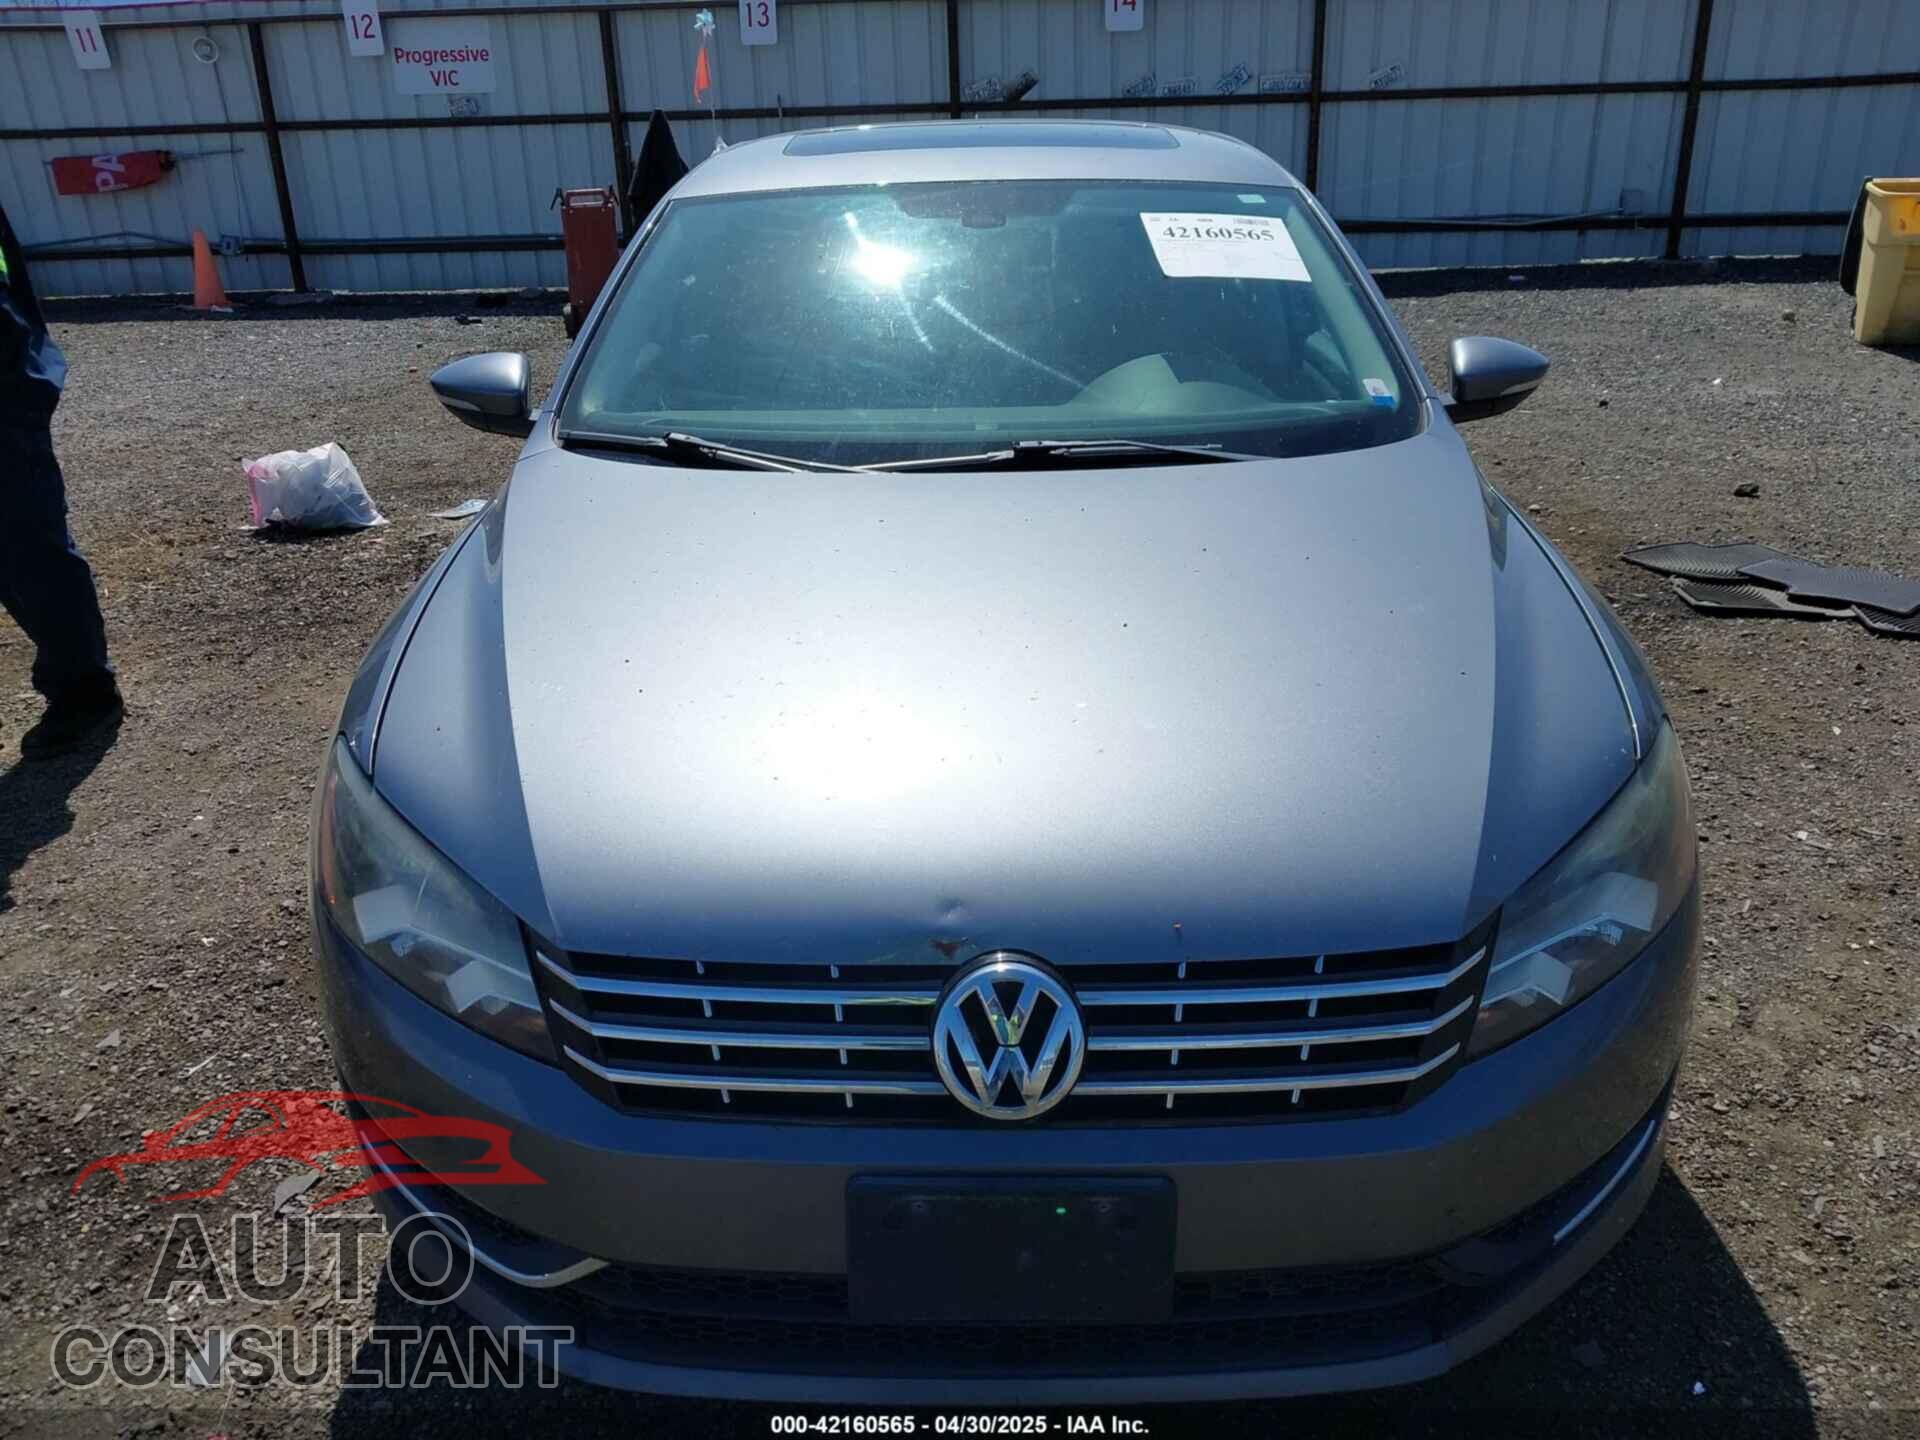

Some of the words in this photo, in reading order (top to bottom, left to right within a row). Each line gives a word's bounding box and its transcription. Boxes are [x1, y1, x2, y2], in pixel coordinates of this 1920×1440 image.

[746, 2, 769, 27] 13
[351, 14, 376, 40] 12
[75, 28, 97, 52] 11
[394, 45, 489, 66] Progressive
[430, 70, 460, 87] VIC
[1162, 226, 1275, 242] 42160565
